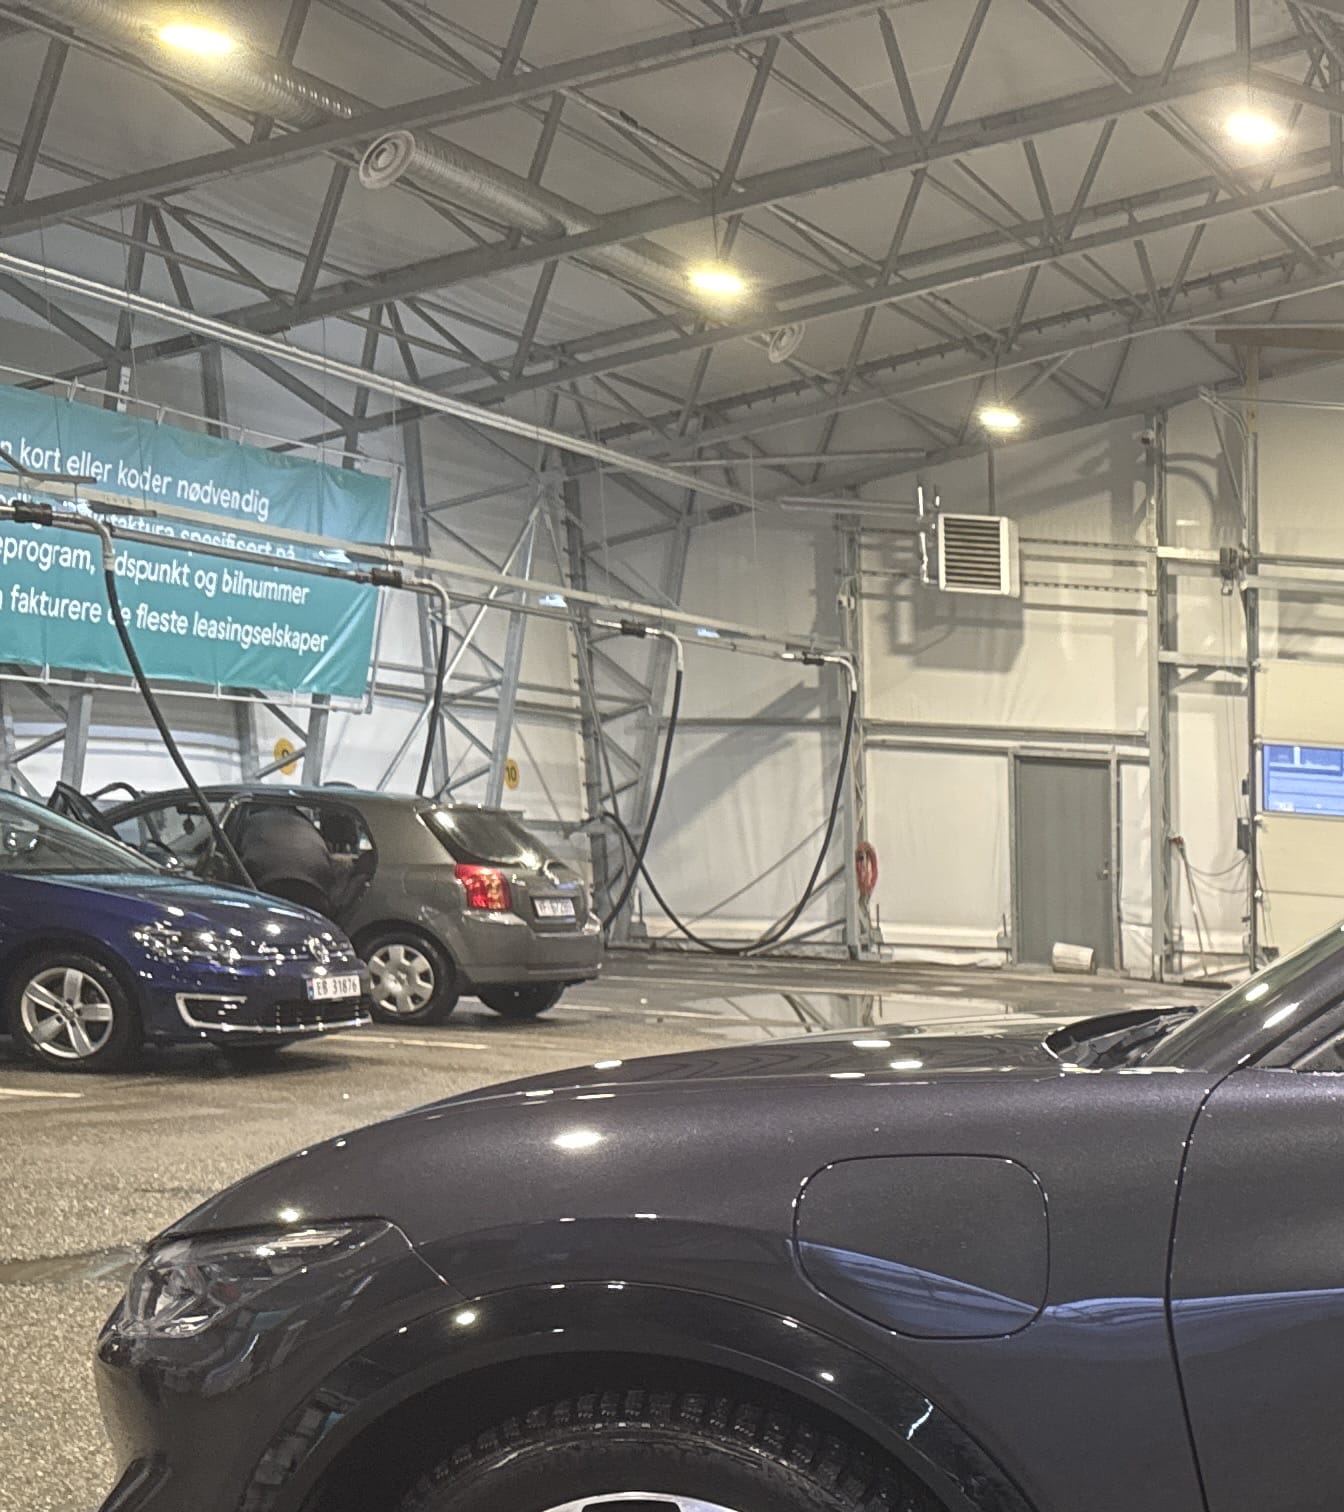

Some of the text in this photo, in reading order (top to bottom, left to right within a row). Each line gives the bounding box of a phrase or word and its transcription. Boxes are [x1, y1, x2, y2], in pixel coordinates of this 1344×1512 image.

[20, 437, 62, 472] kort
[67, 452, 113, 483] eller
[118, 460, 172, 495] koder
[177, 479, 270, 523] nødvendig
[112, 549, 191, 588] dspunkt
[194, 570, 217, 599] og
[222, 571, 311, 606] bilnummer
[11, 583, 102, 624] fakturere
[136, 602, 190, 635] fleste
[192, 608, 329, 654] leasingselskaper
